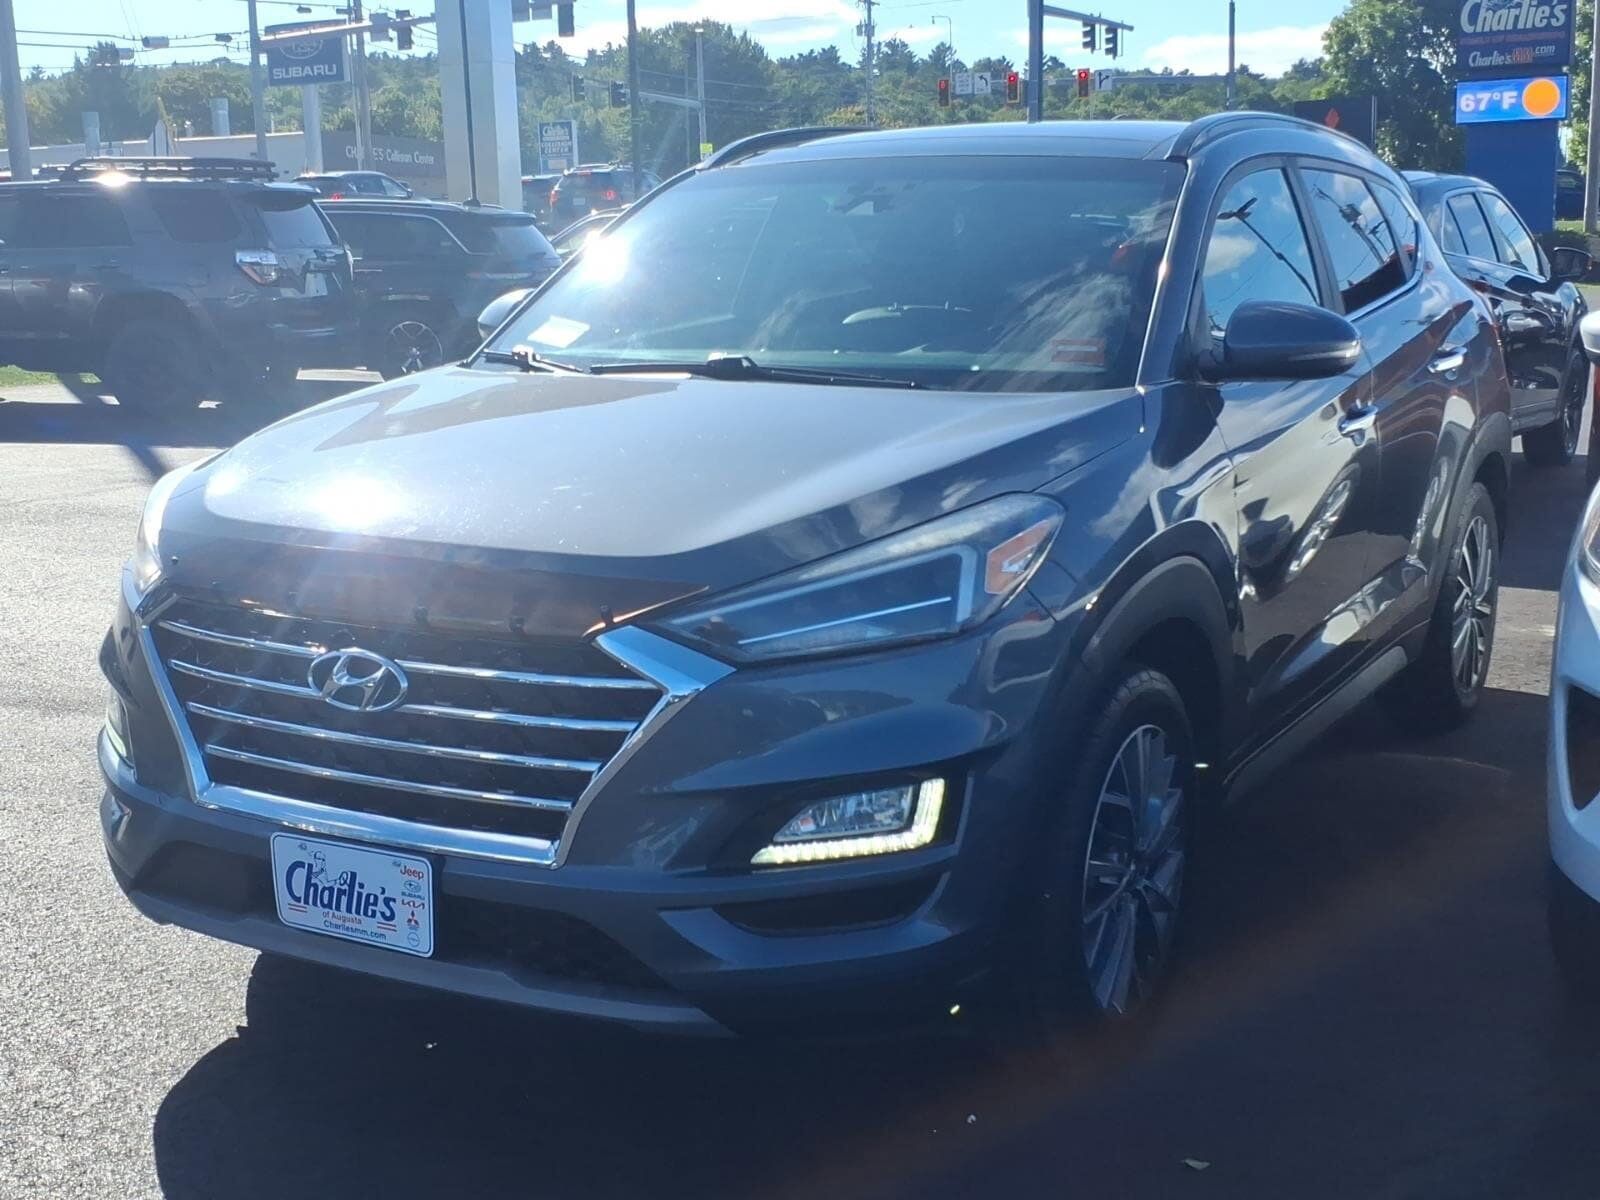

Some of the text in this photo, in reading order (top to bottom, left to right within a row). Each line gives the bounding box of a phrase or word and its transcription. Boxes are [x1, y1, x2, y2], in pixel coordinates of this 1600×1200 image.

[1460, 0, 1568, 33] Charlie's
[273, 64, 336, 79] SUBARU
[1460, 91, 1518, 112] 67°F
[400, 865, 424, 881] Jeep
[285, 861, 397, 921] Charlie's
[322, 910, 362, 925] of Augusta
